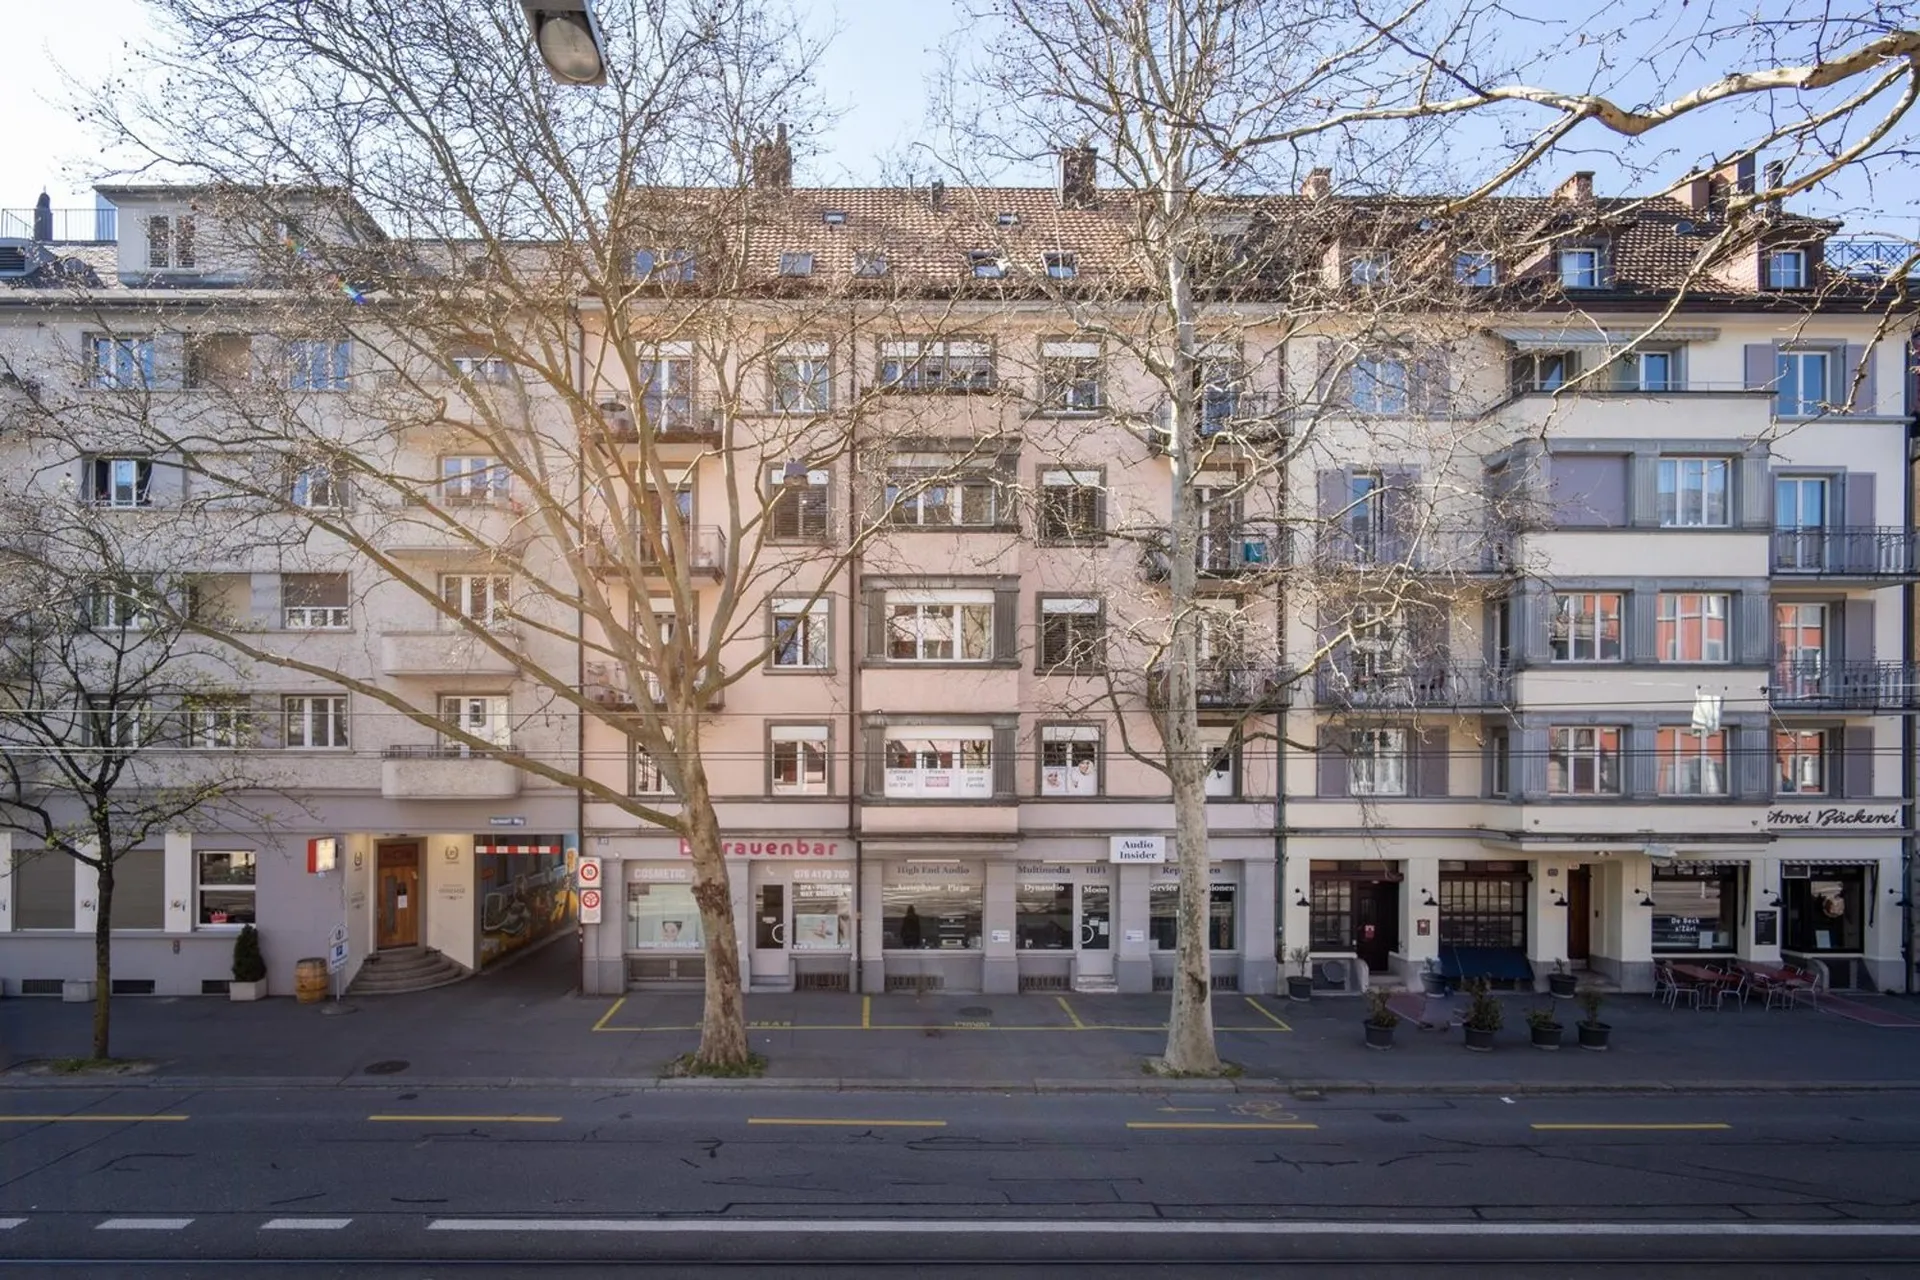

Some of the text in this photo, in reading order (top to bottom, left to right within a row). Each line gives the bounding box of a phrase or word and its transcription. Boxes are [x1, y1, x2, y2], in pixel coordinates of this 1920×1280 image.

[1816, 809, 1899, 827] Bäckerei
[1123, 840, 1154, 849] Audio
[1119, 851, 1157, 860] Insider
[634, 868, 686, 879] COSMETIC
[896, 866, 970, 876] High End Audio
[1017, 866, 1071, 874] Multimedia
[1024, 883, 1109, 894] Dynaudio Moon
